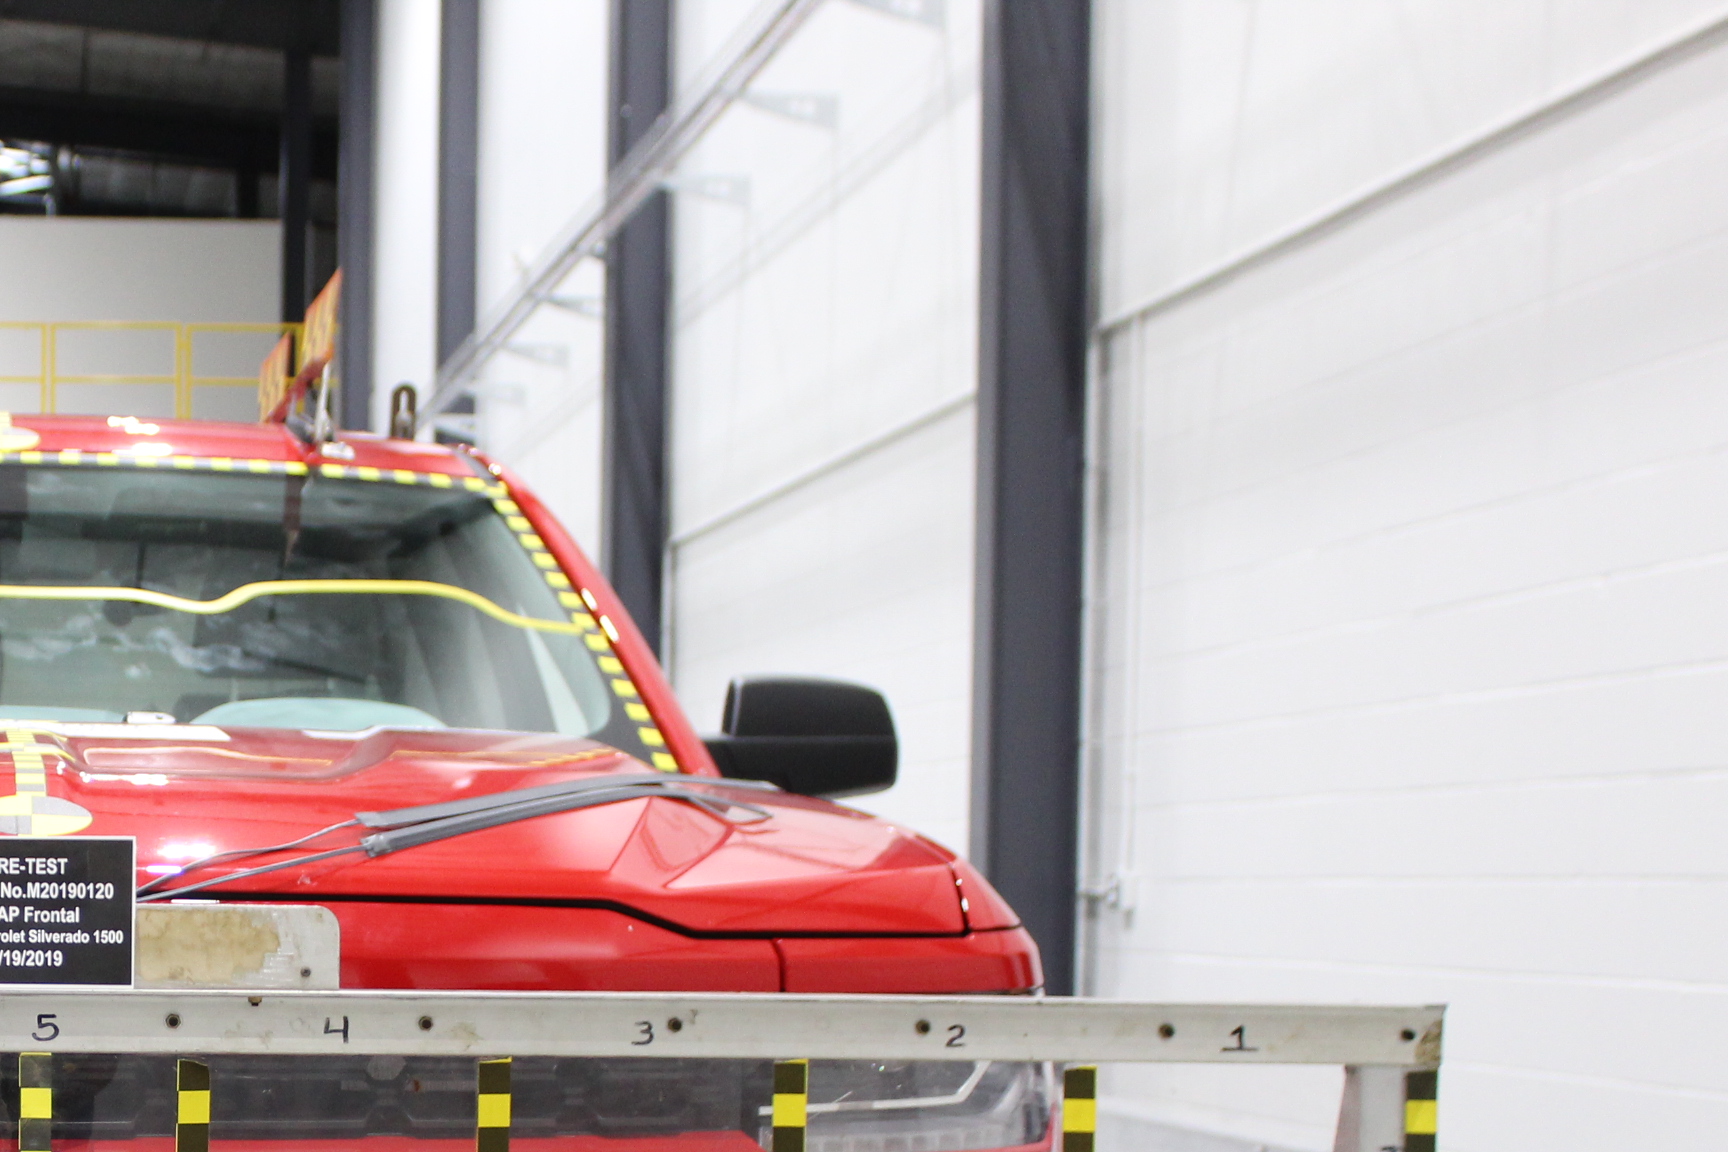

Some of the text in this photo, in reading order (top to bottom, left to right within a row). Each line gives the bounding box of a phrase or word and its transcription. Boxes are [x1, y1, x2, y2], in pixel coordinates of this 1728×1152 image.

[0, 882, 114, 900] No.M20190120
[24, 906, 80, 923] Frontal
[28, 929, 90, 943] Silverado
[93, 930, 124, 944] 1500
[31, 1013, 60, 1042] 5
[323, 1015, 349, 1043] 4
[630, 1020, 654, 1046] 3
[946, 1024, 966, 1048] 2
[1221, 1025, 1258, 1052] 1
